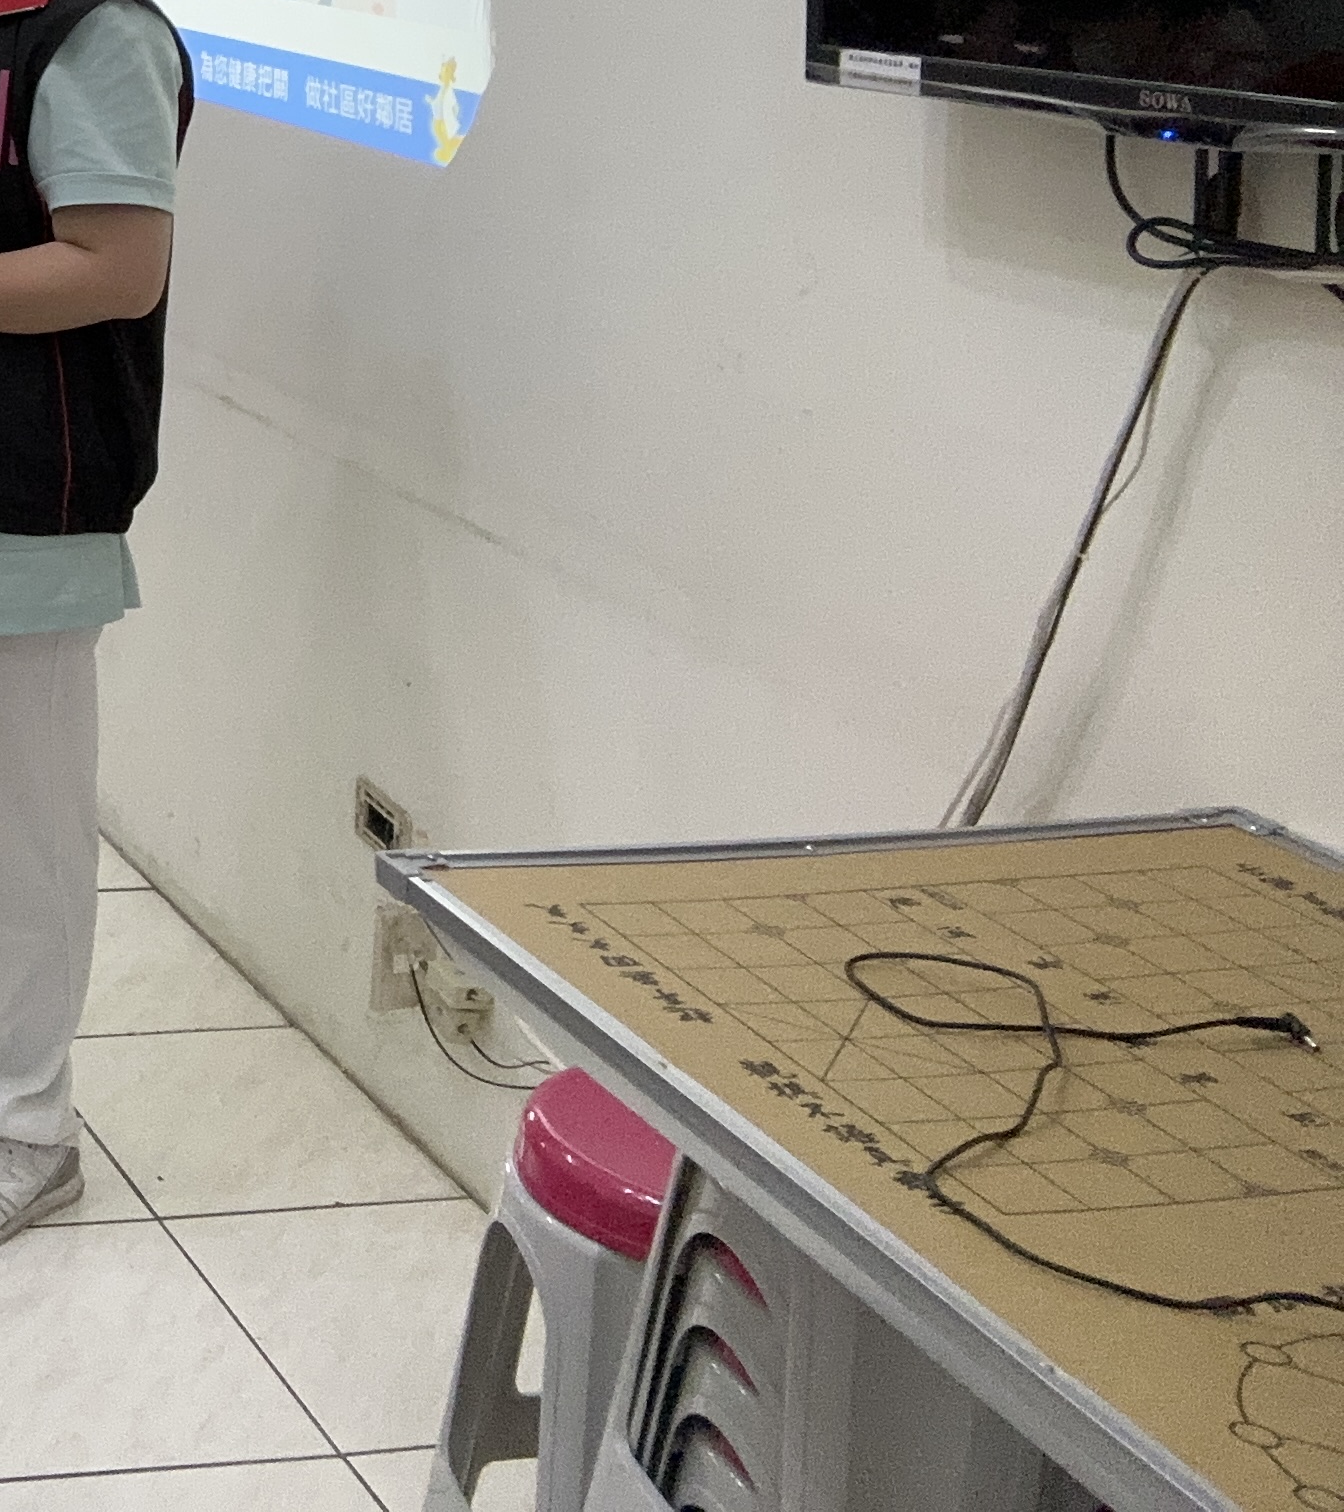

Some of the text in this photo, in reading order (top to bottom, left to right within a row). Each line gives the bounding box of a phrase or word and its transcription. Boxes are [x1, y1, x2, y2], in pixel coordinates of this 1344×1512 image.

[199, 49, 414, 136] 為您健康把關 做社區好鄰居
